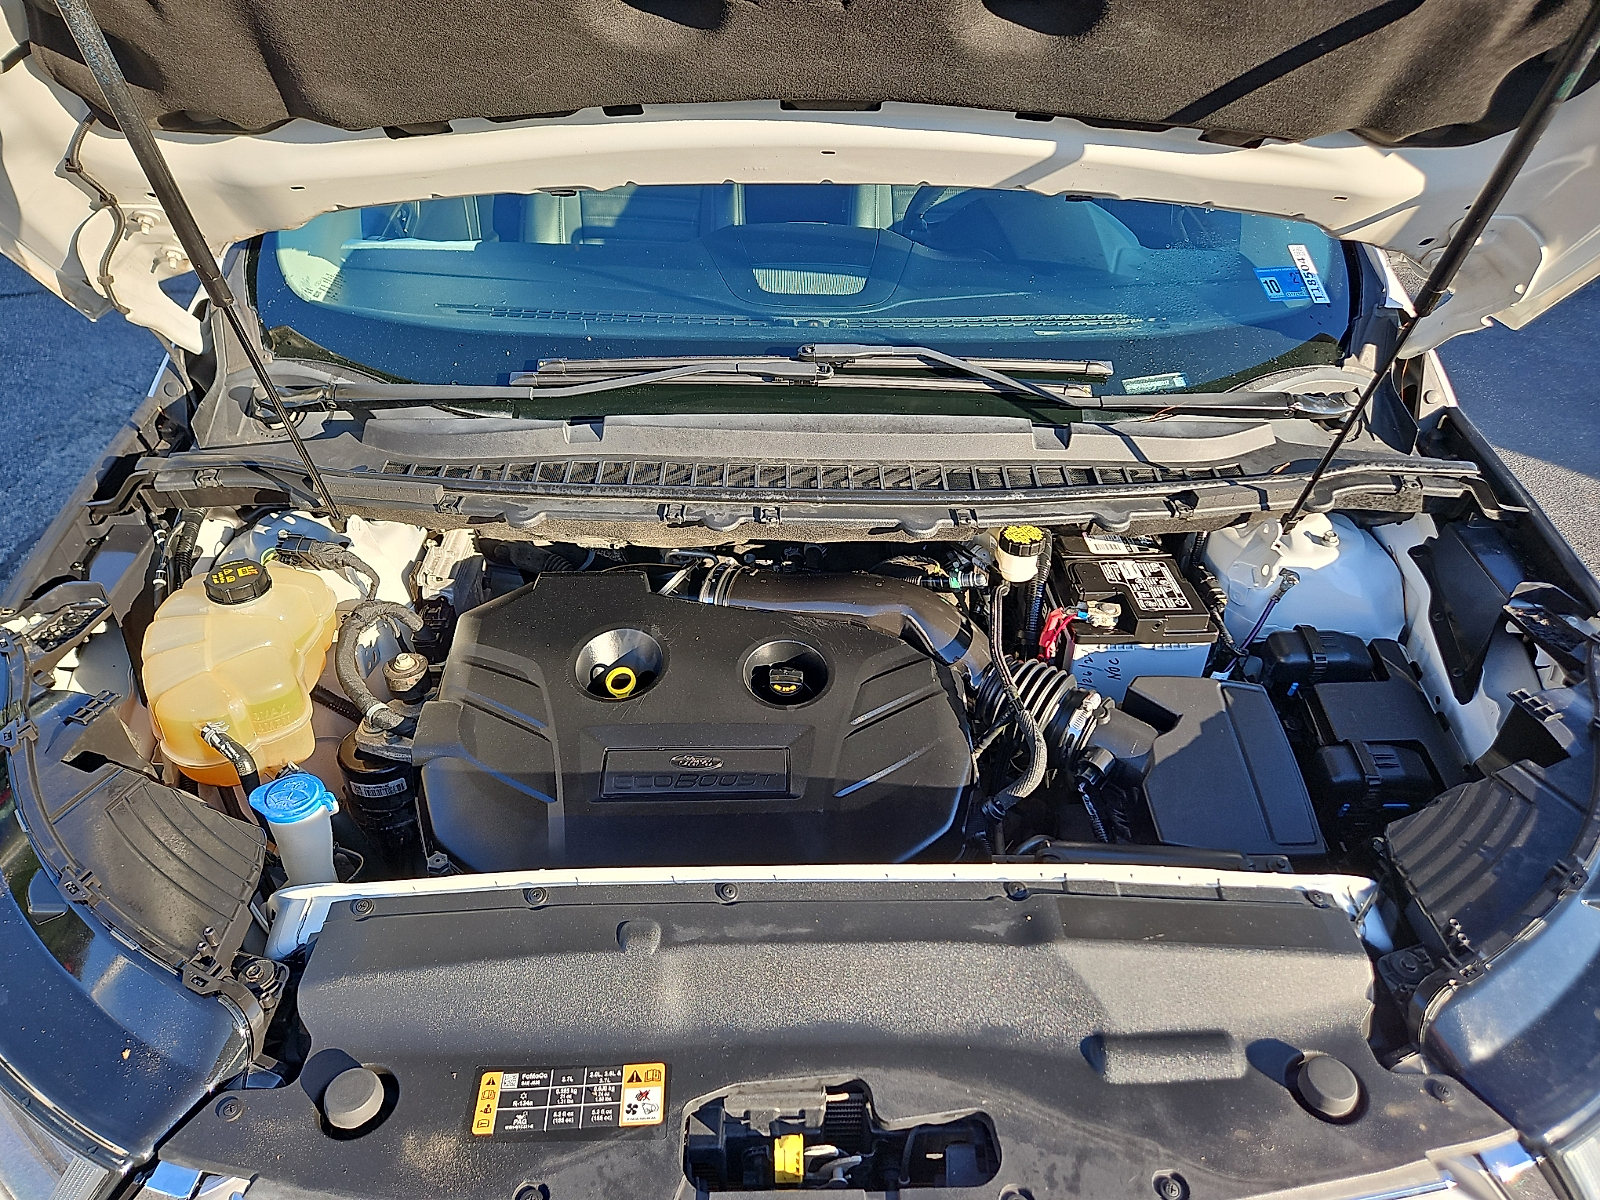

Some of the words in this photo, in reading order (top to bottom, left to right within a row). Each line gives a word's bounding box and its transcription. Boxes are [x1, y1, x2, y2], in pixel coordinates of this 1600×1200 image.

[1263, 279, 1281, 294] 10
[1297, 257, 1325, 302] T18504
[1104, 657, 1122, 681] NOC
[676, 754, 717, 768] Ford
